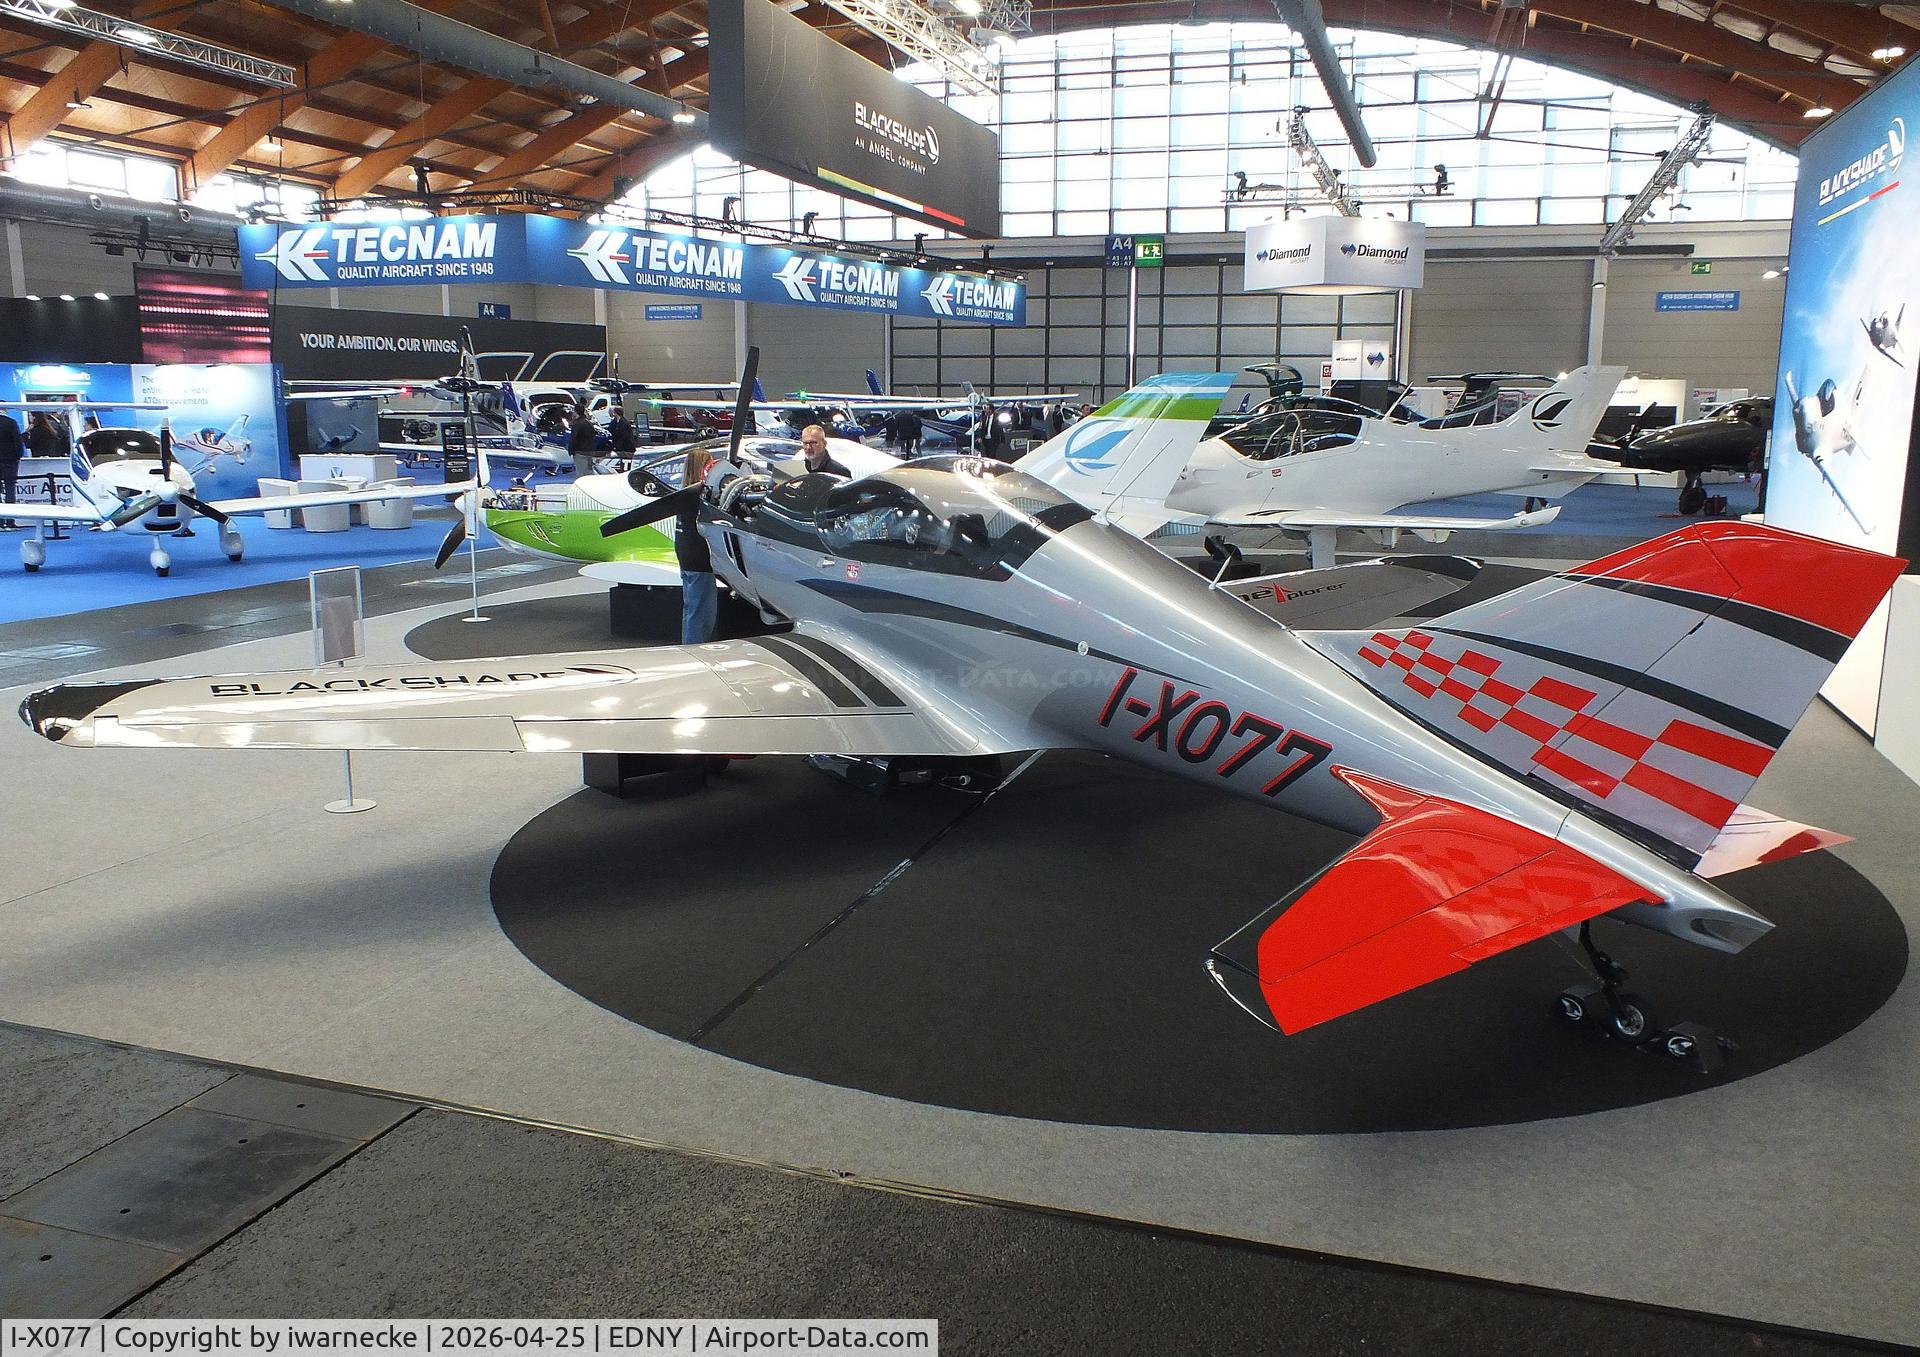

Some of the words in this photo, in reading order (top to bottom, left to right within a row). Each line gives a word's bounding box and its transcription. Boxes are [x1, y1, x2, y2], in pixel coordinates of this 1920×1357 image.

[855, 101, 927, 156] BLACKSHAPE
[854, 136, 865, 150] AN
[868, 140, 895, 163] ANGEL
[898, 155, 927, 176] COMPANY
[1819, 143, 1889, 206] BLACKSHAPE
[331, 222, 498, 263] TECNAM
[1112, 237, 1132, 250] A4
[1269, 244, 1312, 261] Diamond
[1357, 244, 1409, 259] Diamond
[631, 236, 744, 280] TECNAM
[337, 266, 380, 280] QUALITY
[381, 264, 434, 279] AIRCRAFT
[435, 263, 468, 277] SINCE
[470, 262, 494, 276] 1948
[818, 261, 899, 297] TECNAM
[635, 272, 668, 288] QUALITY
[668, 276, 704, 291] AIRCRAFT
[705, 279, 727, 293] SINCE
[727, 281, 742, 294] 1948
[820, 292, 843, 304] QUALITY
[844, 293, 870, 307] AIRCRAFT
[870, 296, 886, 309] SINCE
[886, 298, 898, 310] 1948
[954, 281, 1016, 311] TECNAM
[483, 303, 495, 316] A4
[956, 307, 973, 317] QUALITY
[974, 308, 993, 319] AIRCRAFT
[300, 333, 335, 349] YOUR
[337, 335, 397, 352] AMBITION,
[397, 337, 421, 351] OUR
[422, 339, 460, 353] WINGS.
[41, 481, 72, 495] Arc
[1098, 667, 1334, 798] I-X077
